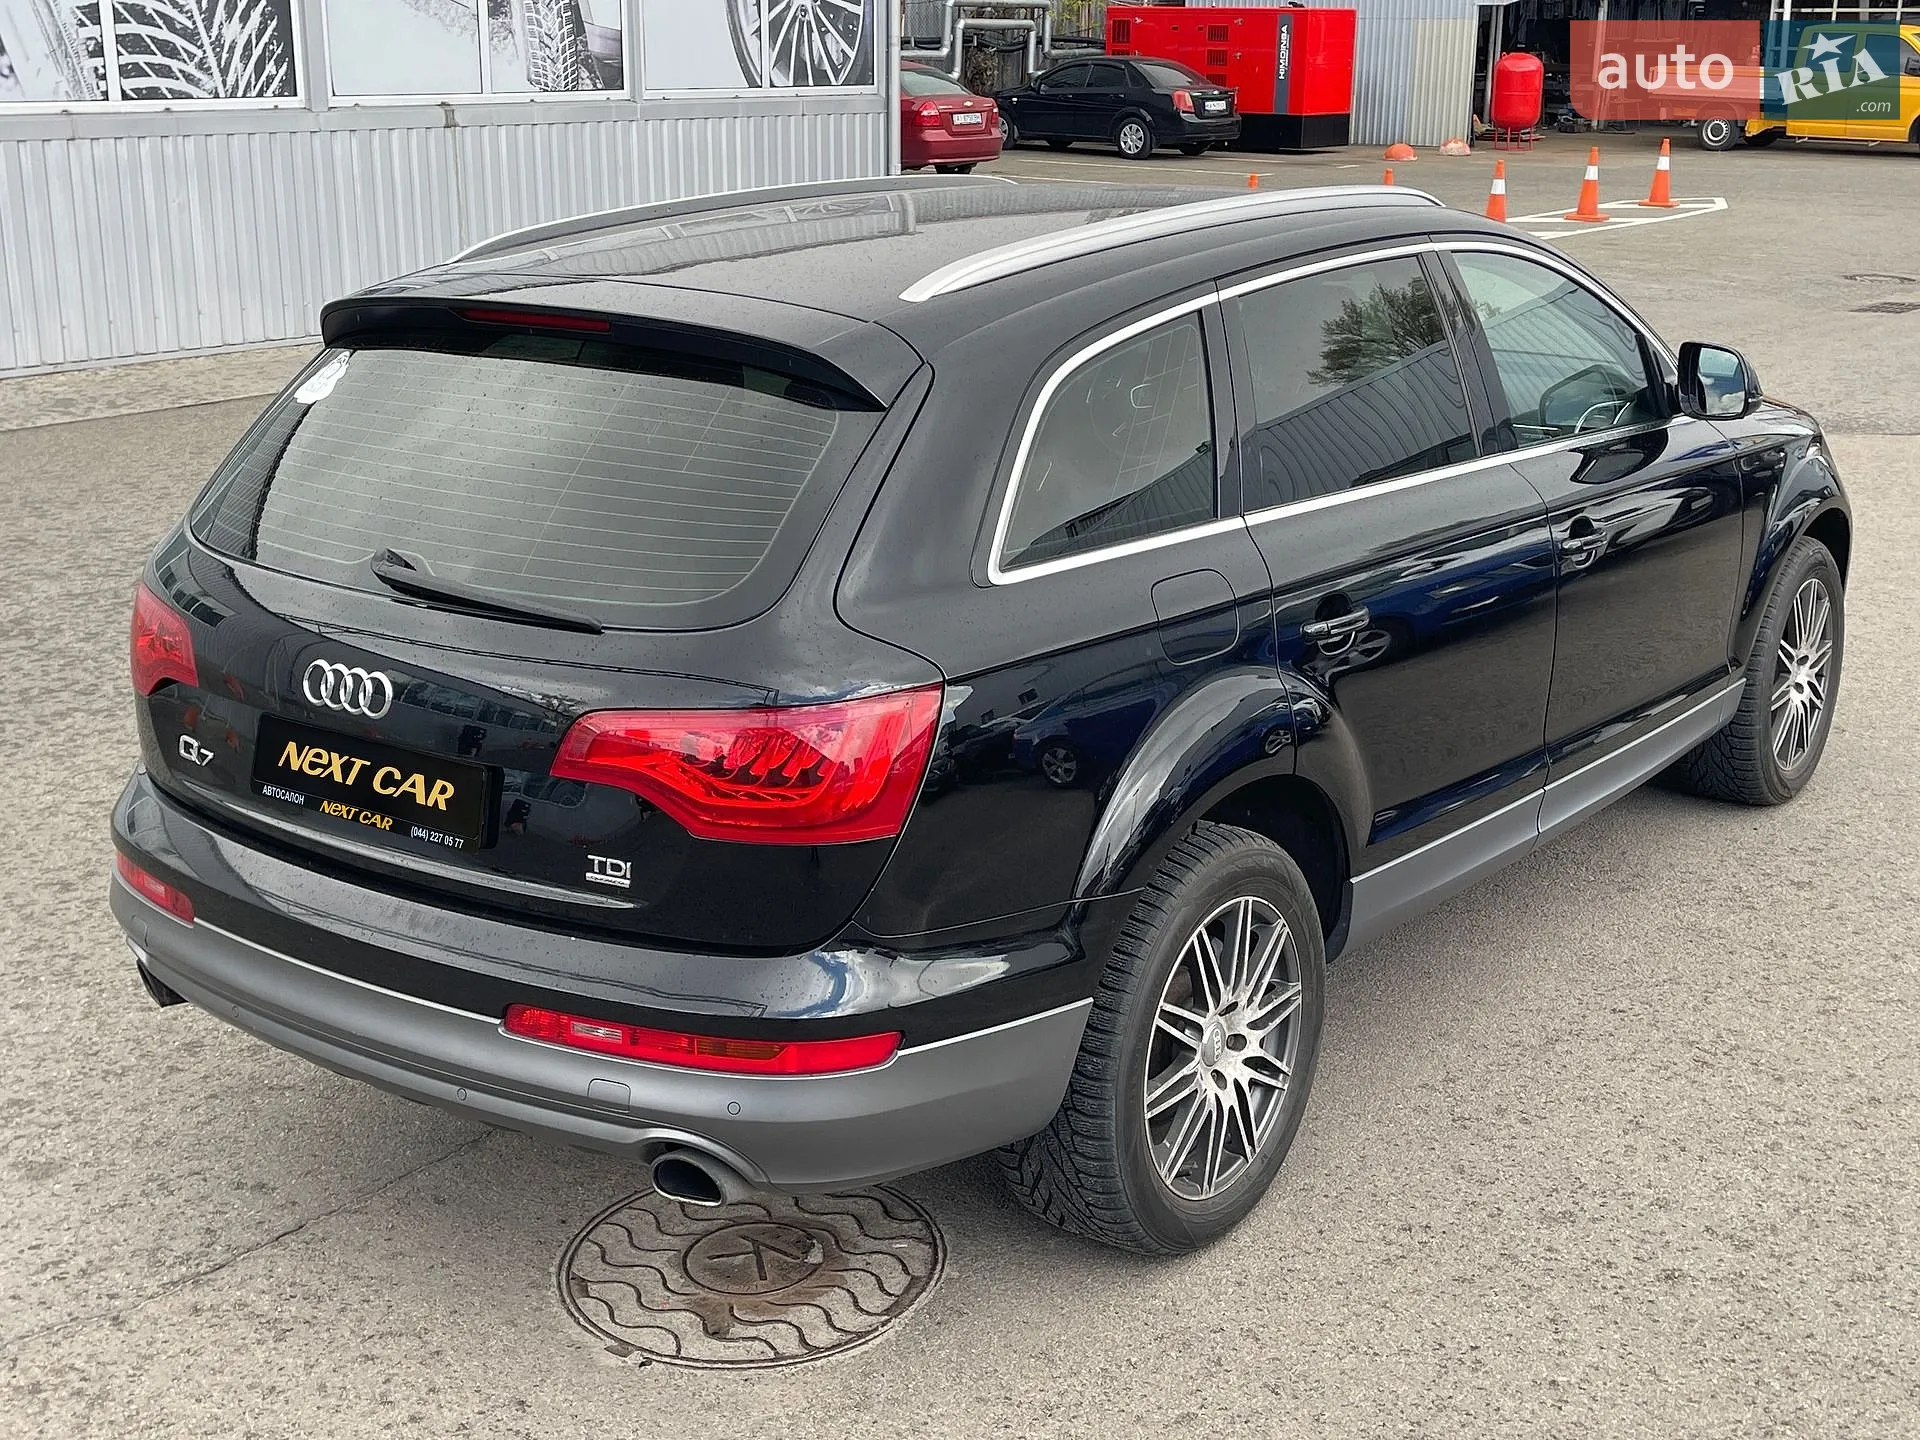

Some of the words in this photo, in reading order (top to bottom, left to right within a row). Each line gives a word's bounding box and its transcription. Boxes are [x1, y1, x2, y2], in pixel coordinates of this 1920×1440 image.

[179, 734, 214, 766] Q7
[262, 784, 305, 805] АВТОСАЛОН
[372, 766, 455, 811] CAR
[359, 811, 393, 831] CAR
[410, 825, 429, 842] (044)
[430, 830, 444, 843] 227
[444, 835, 454, 847] 05
[454, 837, 464, 849] 77
[587, 854, 632, 879] TDI
